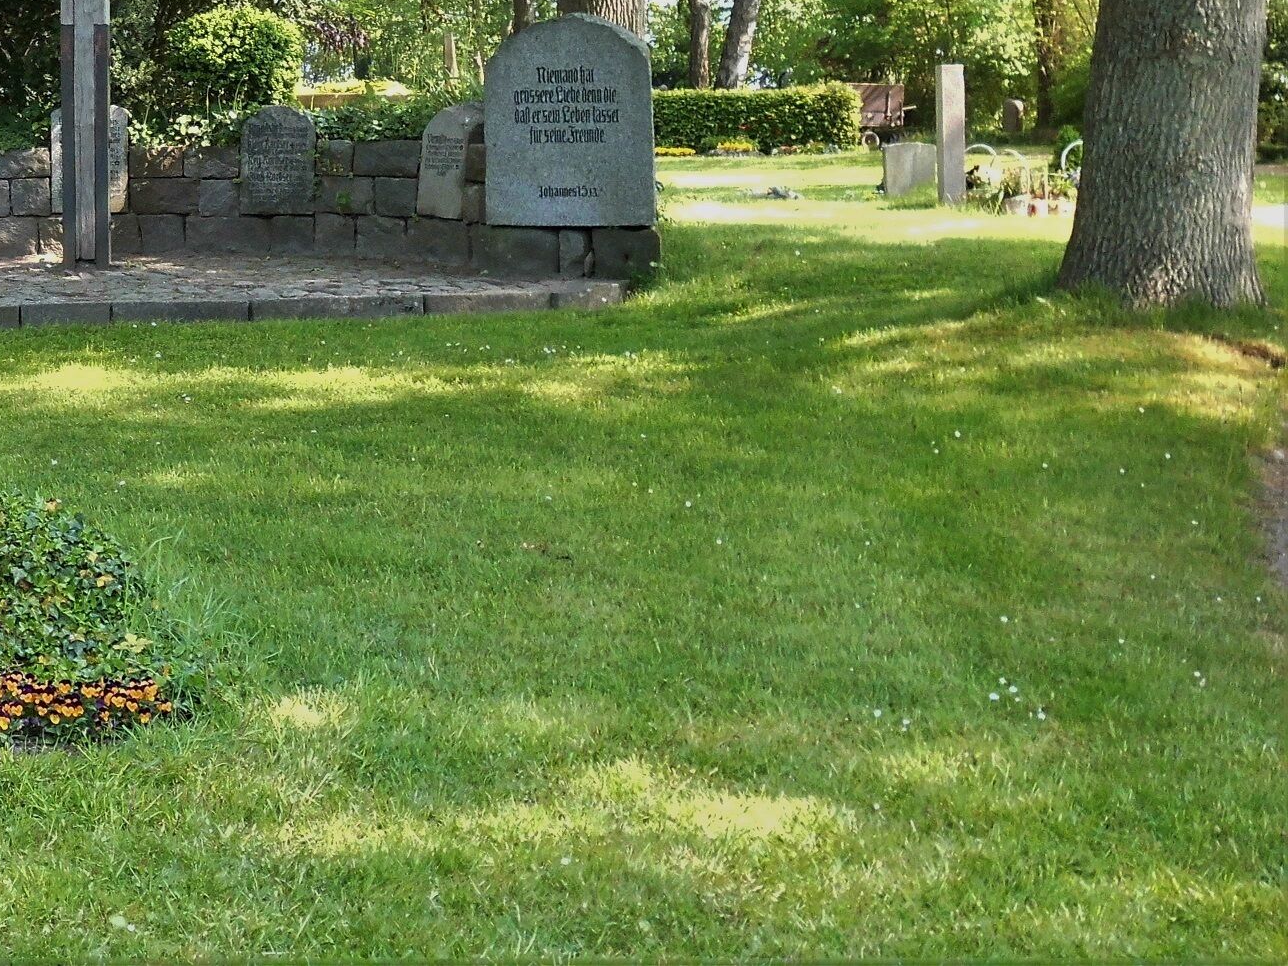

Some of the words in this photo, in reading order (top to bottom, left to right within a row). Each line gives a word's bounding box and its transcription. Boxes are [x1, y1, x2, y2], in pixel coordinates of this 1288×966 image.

[536, 66, 579, 84] Niemand
[579, 65, 594, 84] hat
[555, 85, 580, 103] Liebe
[581, 87, 602, 103] denn
[532, 109, 541, 123] er
[542, 109, 560, 123] sein
[562, 105, 590, 123] Leben
[544, 127, 567, 143] seine
[539, 186, 577, 197] Johannes
